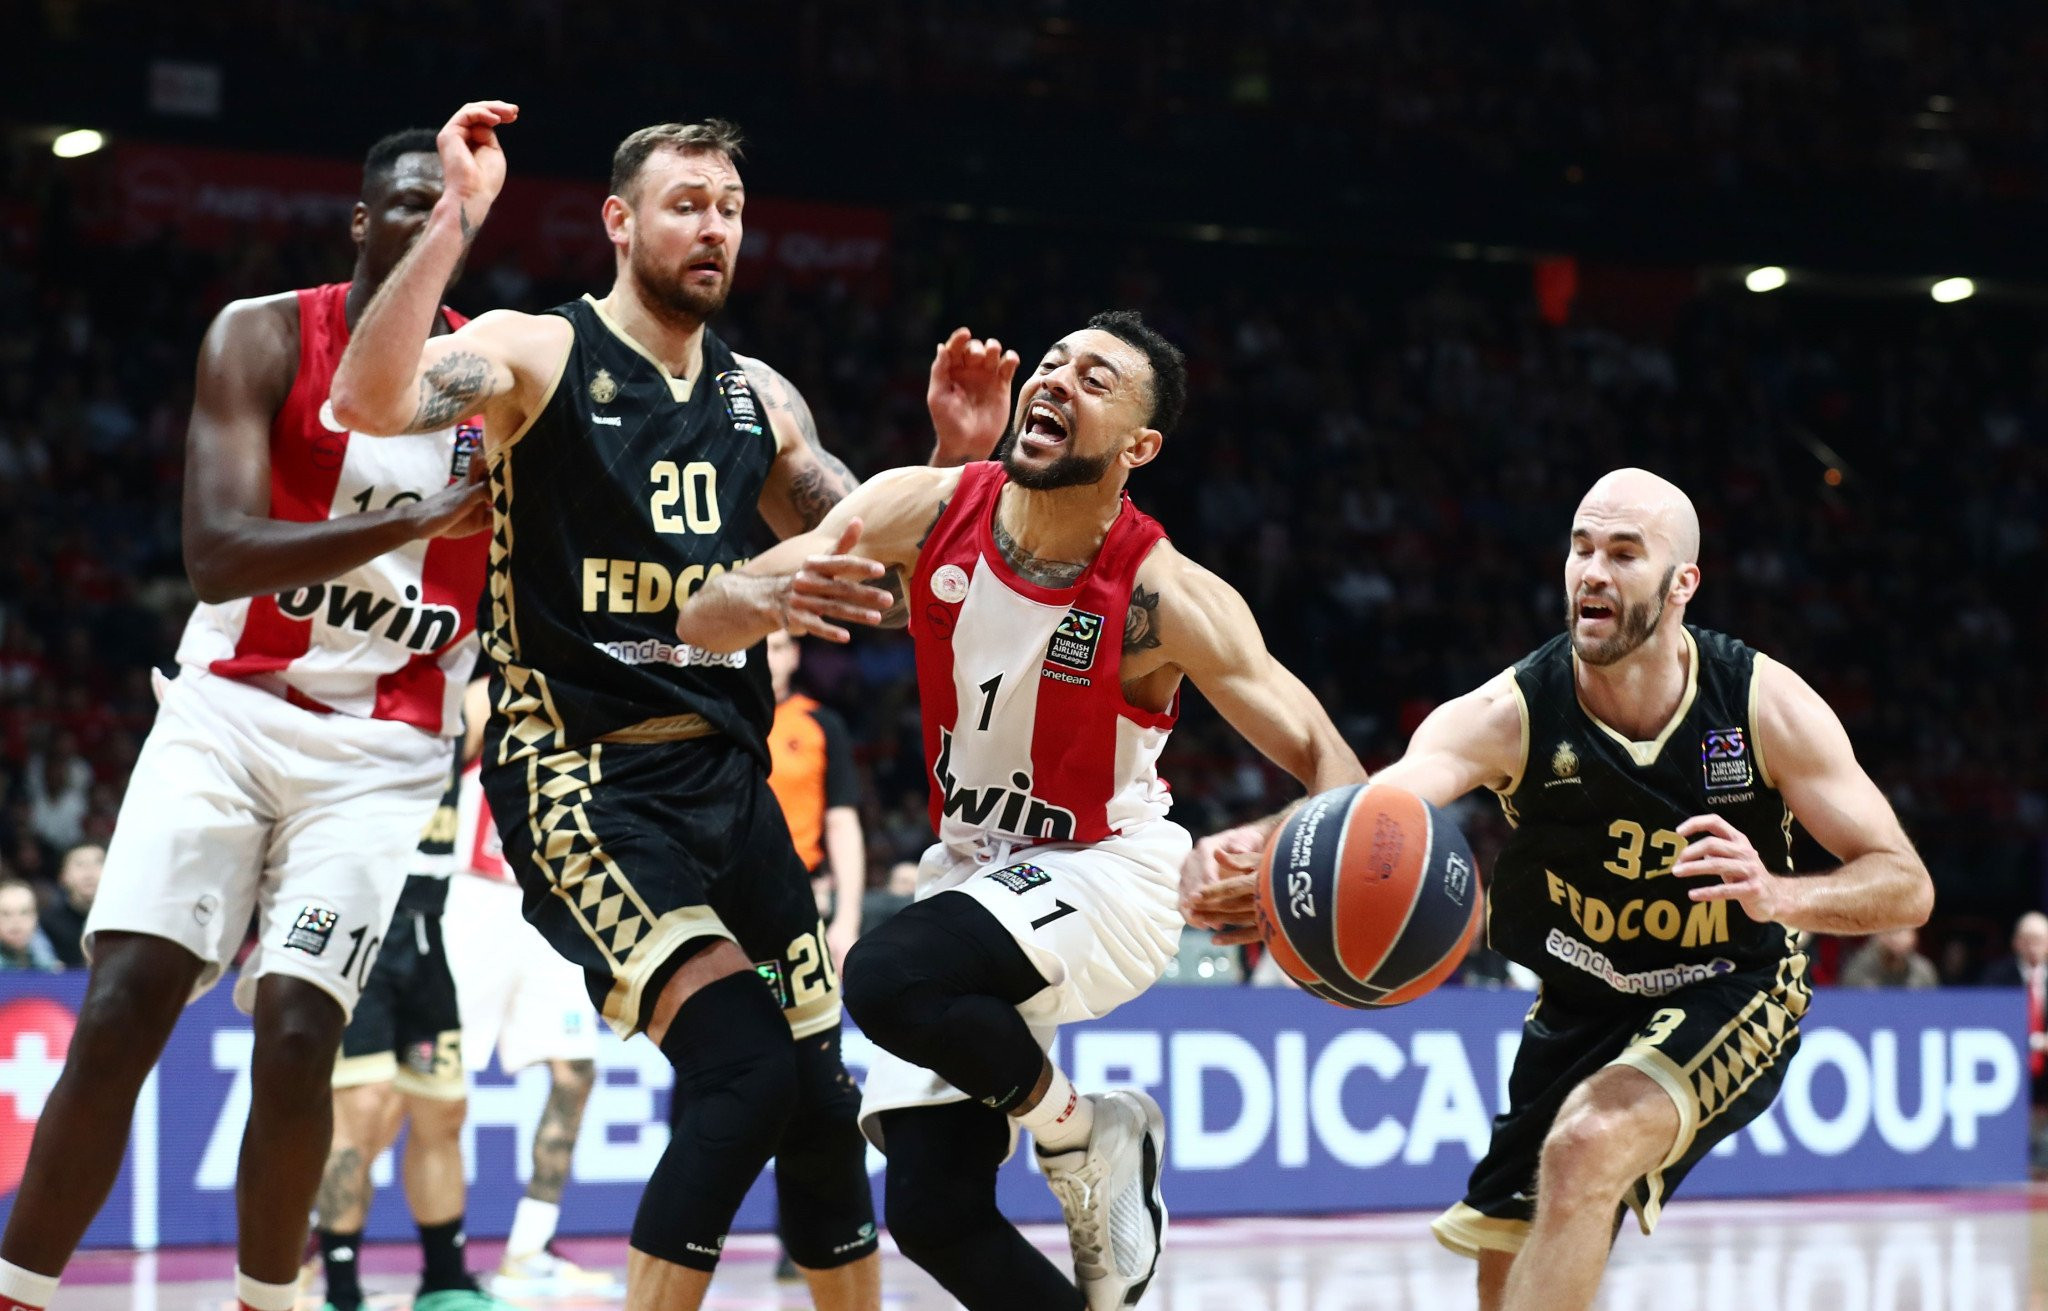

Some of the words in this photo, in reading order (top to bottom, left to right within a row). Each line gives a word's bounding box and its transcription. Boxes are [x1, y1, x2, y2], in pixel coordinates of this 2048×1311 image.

[650, 460, 722, 535] 20
[582, 556, 750, 614] FEDC
[1056, 612, 1098, 641] 25
[1051, 650, 1087, 665] EuroLeague
[1052, 644, 1089, 660] AIRLINES
[1055, 637, 1090, 653] TURKISH
[1042, 668, 1091, 687] oneteam
[977, 672, 1005, 731] 1
[1708, 732, 1746, 758] 25
[1707, 791, 1755, 805] oneteam
[1603, 818, 1689, 880] 33
[1288, 870, 1316, 919] 25
[1545, 868, 1729, 948] FEDCOM
[1030, 898, 1079, 932] 1
[1630, 1008, 1687, 1046] 3
[1026, 1027, 1522, 1172] EDICA
[1711, 1026, 2022, 1157] OUP
